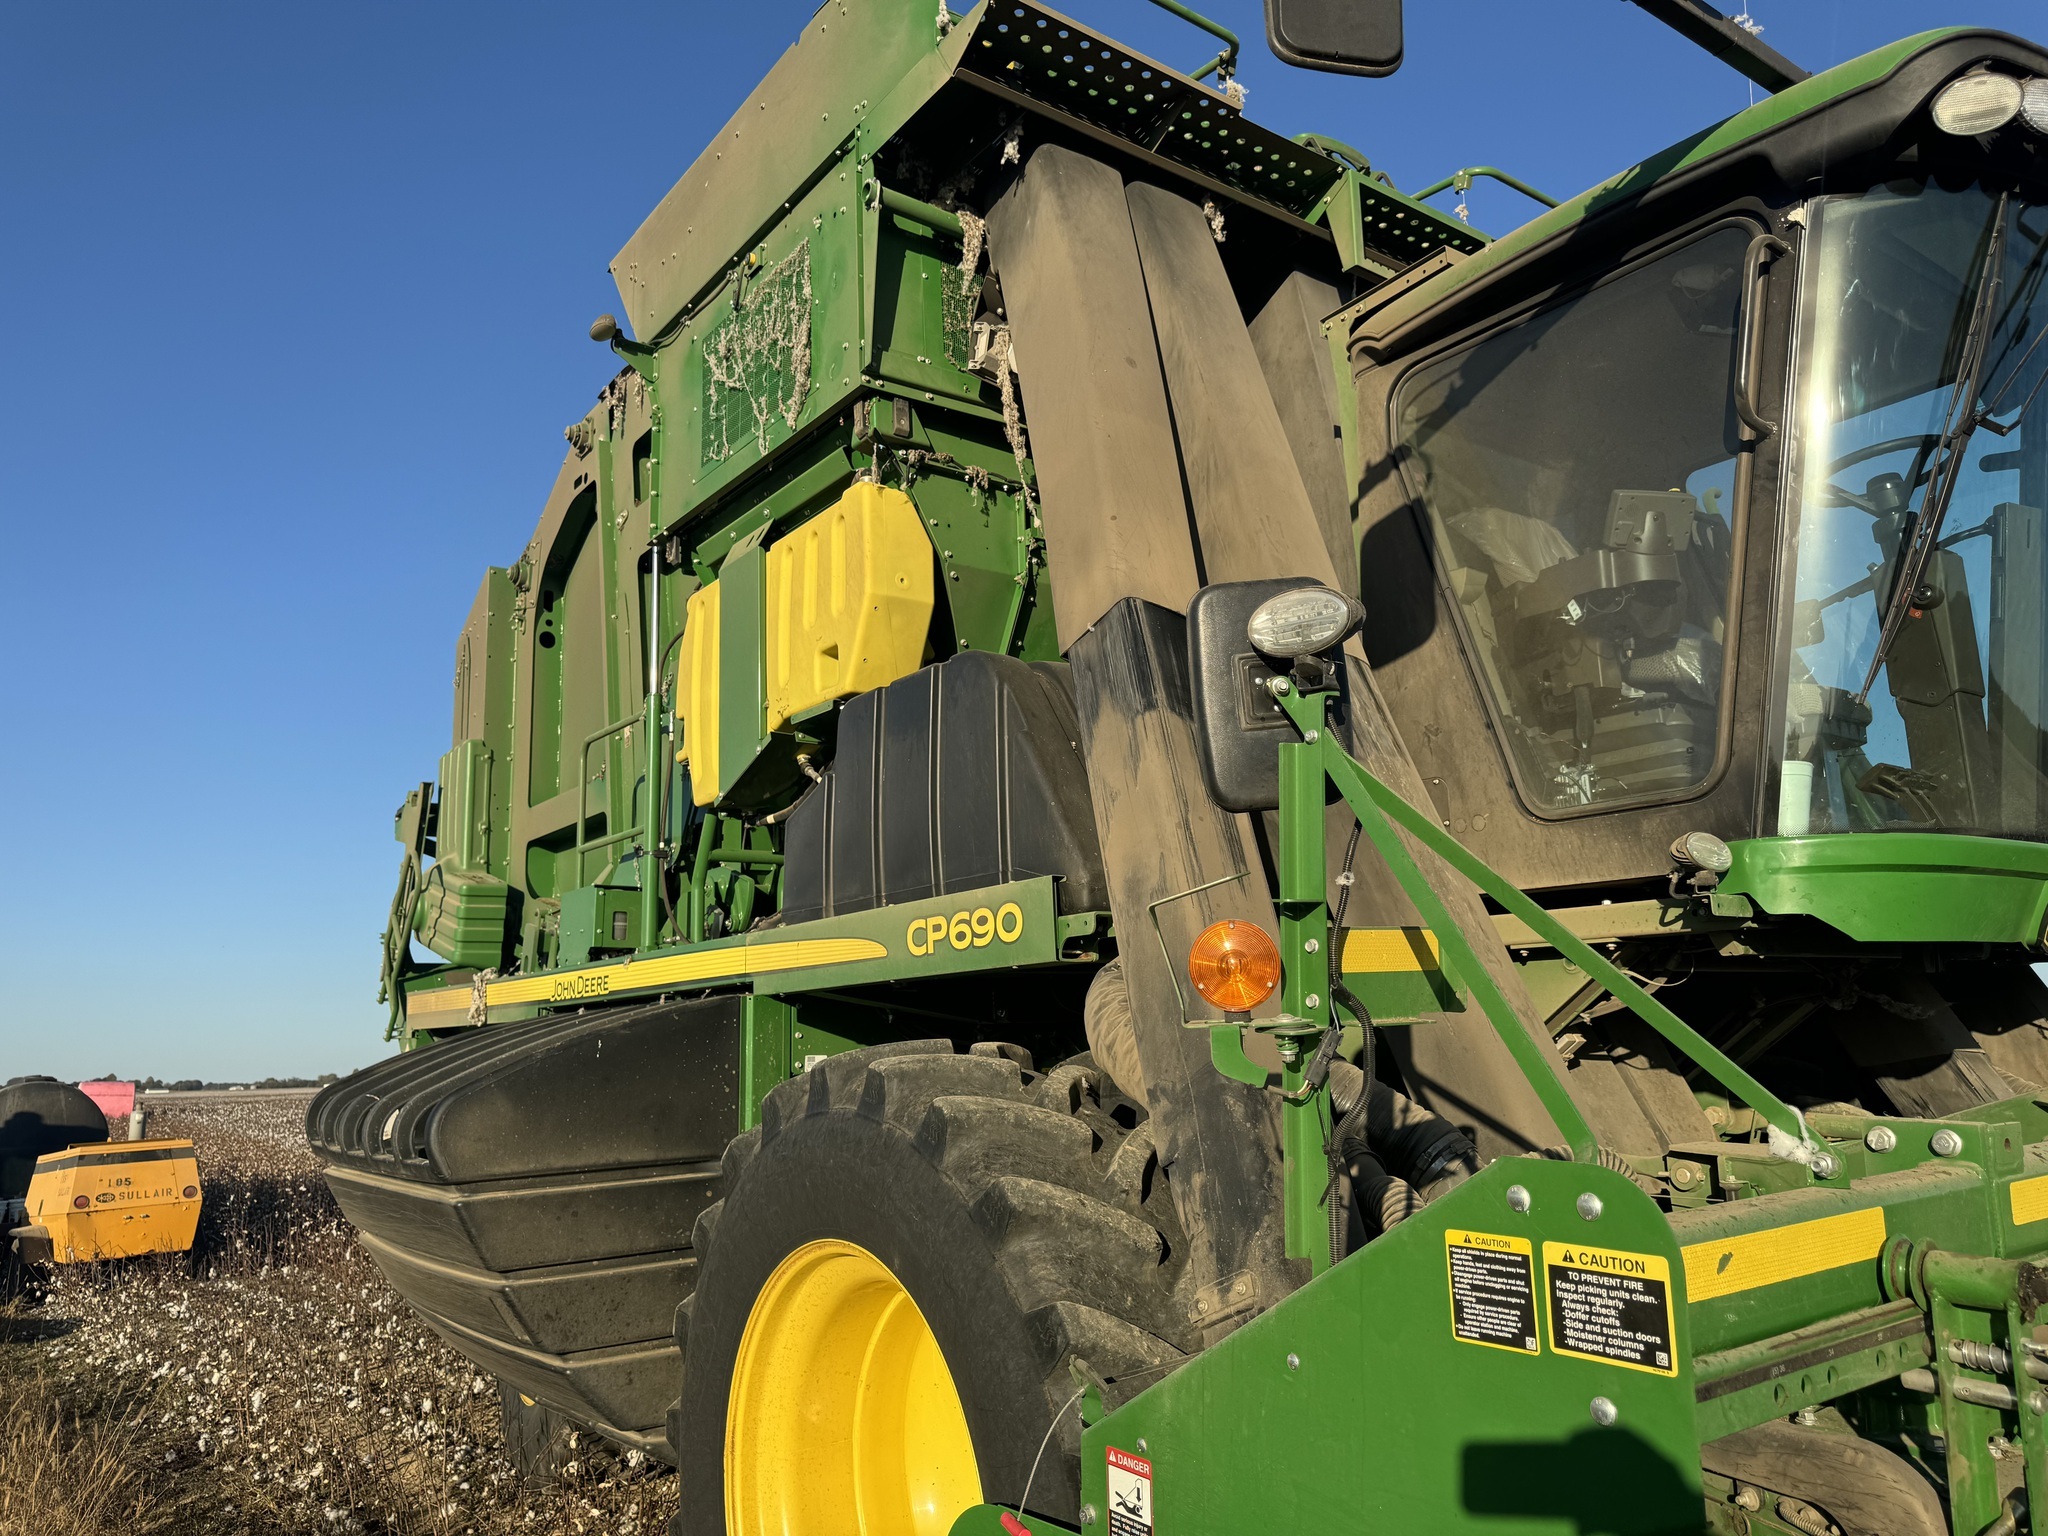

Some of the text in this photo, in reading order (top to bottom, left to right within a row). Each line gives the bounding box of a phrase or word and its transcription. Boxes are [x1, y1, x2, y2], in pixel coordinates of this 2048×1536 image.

[907, 903, 1023, 956] CP690
[119, 1188, 172, 1200] SULLAIR
[1475, 1237, 1511, 1249] CAUTION
[1579, 1252, 1645, 1274] CAUTION
[1556, 1280, 1658, 1304] Keep picking units clean.
[1568, 1272, 1644, 1291] TO PREVENT FIRE
[1556, 1289, 1625, 1309] Inspect regularly.
[1562, 1300, 1619, 1317] Always check:
[1562, 1310, 1620, 1327] -Doffer cutoffs
[1563, 1319, 1661, 1344] -Side and suction doors
[1564, 1328, 1644, 1351] -Moistener columns
[1565, 1338, 1641, 1360] -Wrapped spindles
[1118, 1454, 1149, 1475] DANGER
